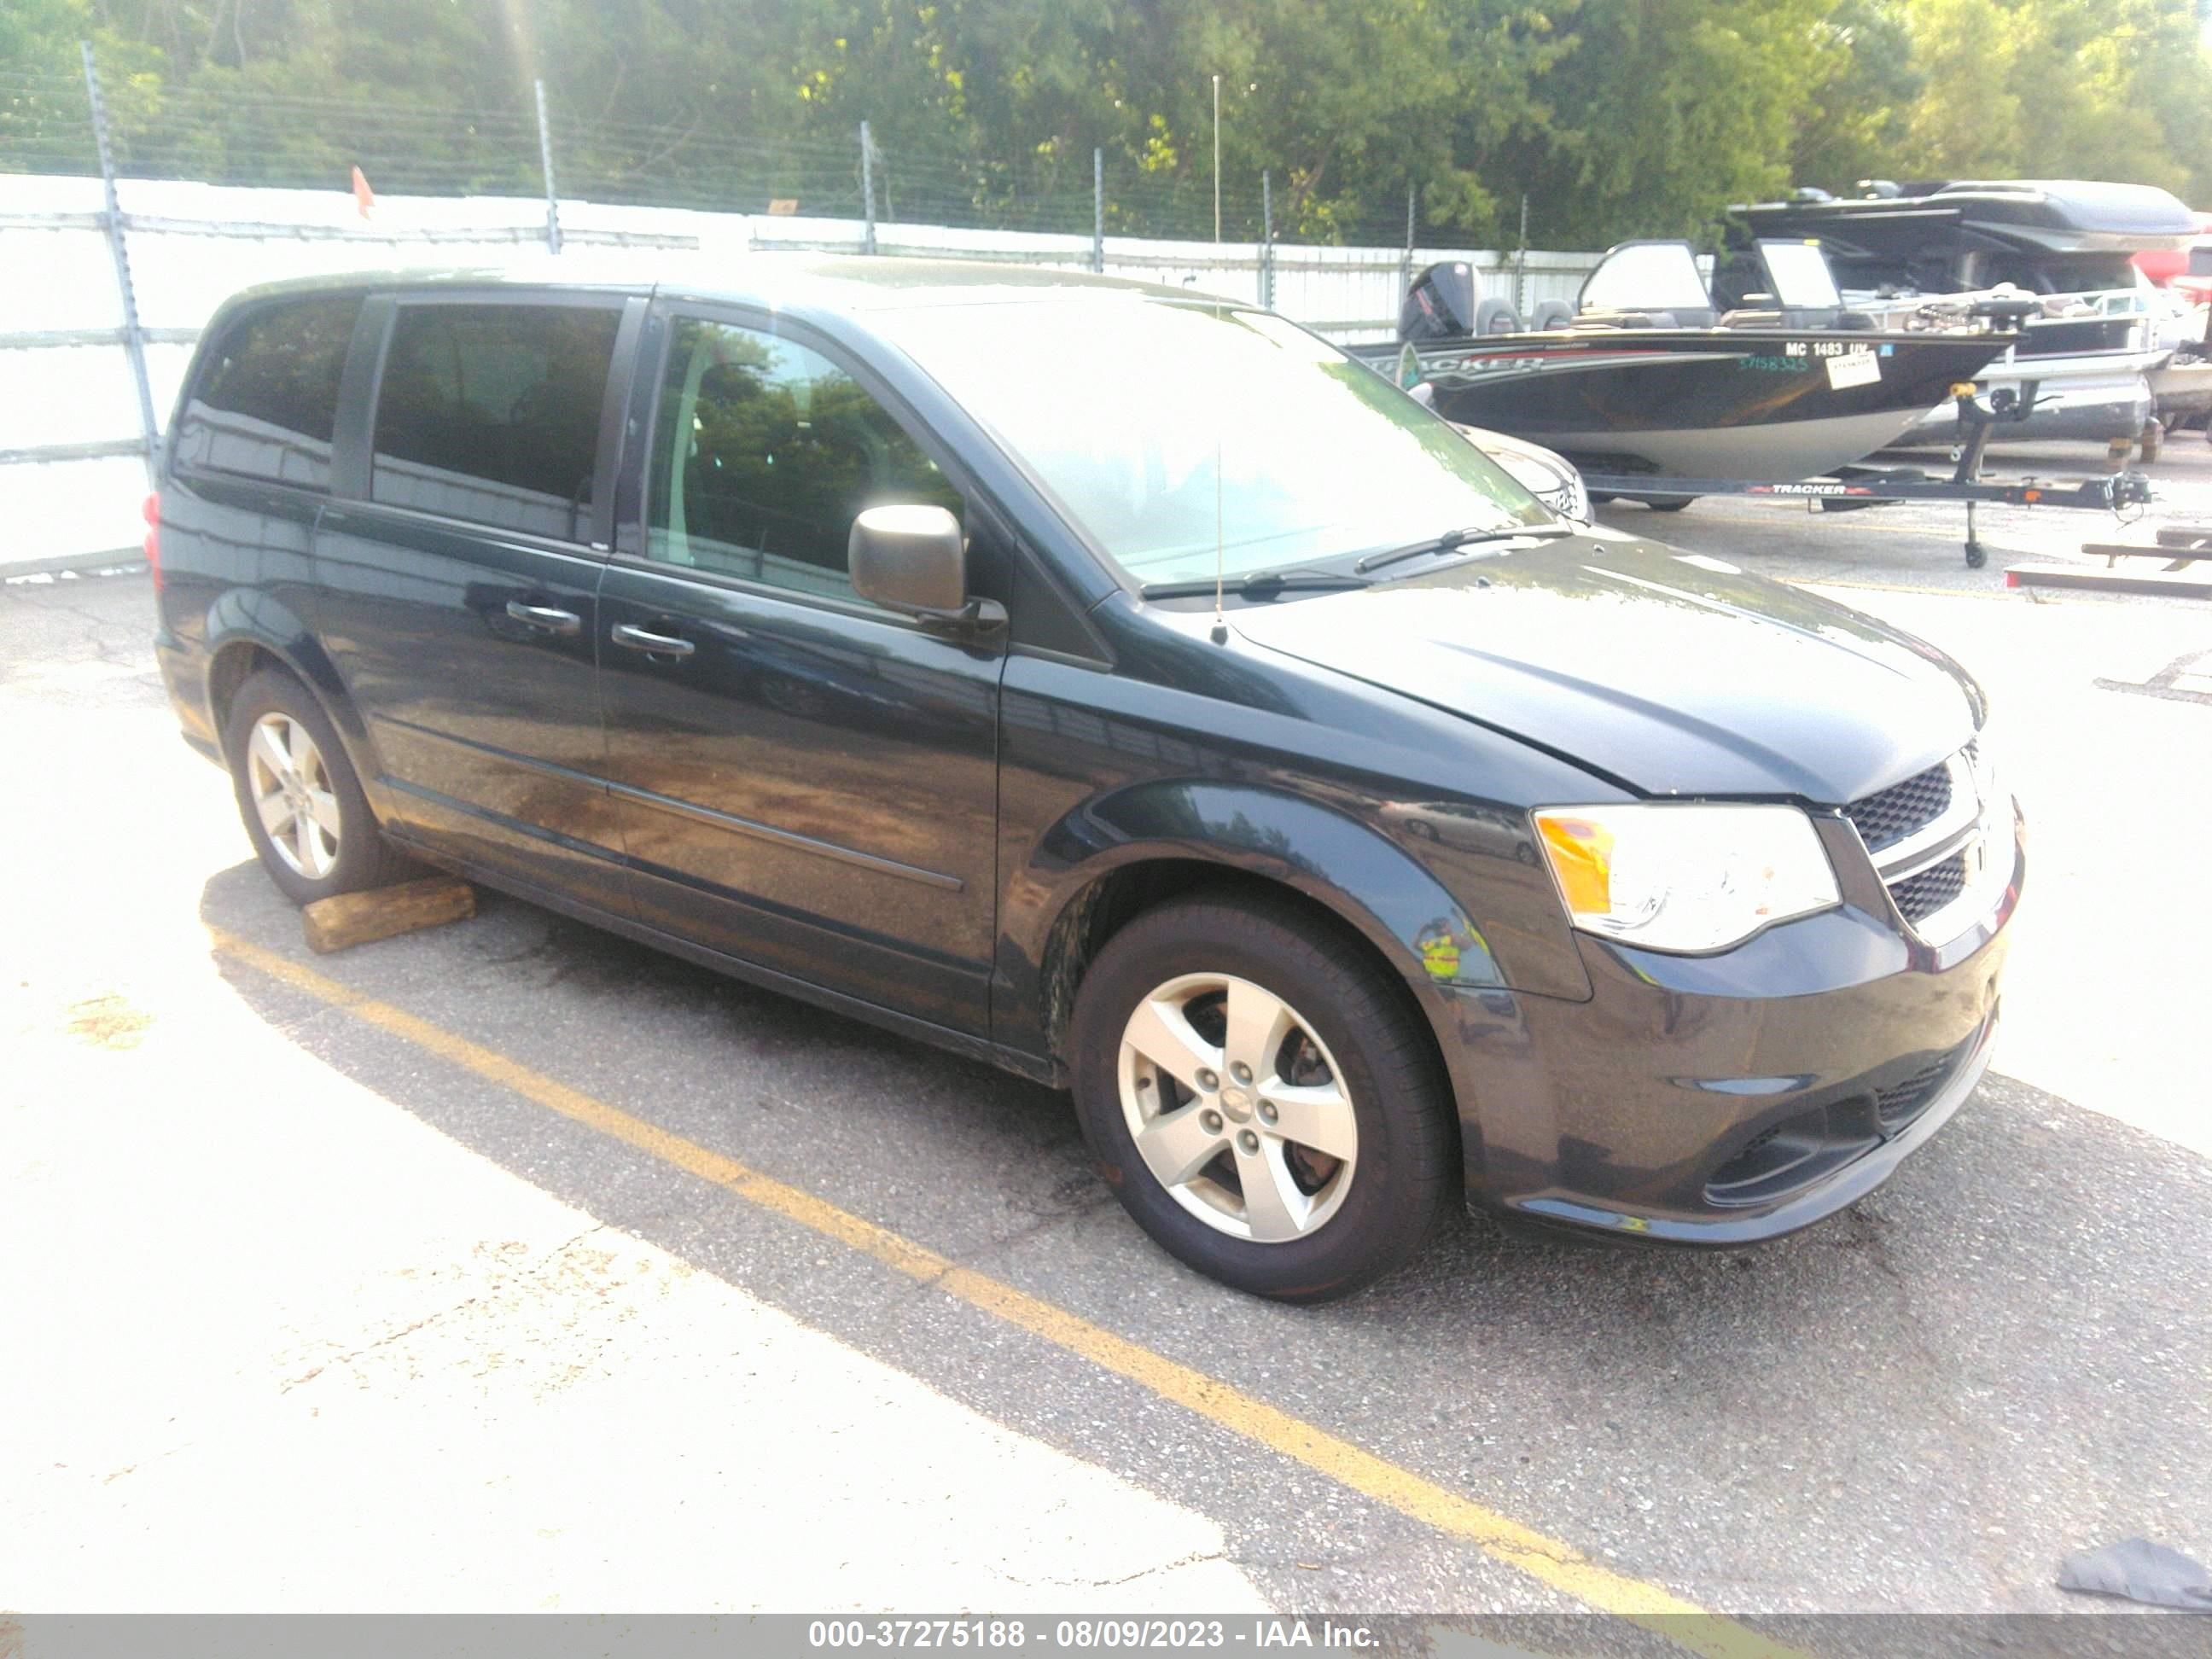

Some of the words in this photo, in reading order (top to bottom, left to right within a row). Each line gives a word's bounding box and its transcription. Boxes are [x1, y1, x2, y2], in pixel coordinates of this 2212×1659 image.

[1786, 342, 1807, 356] MC
[1813, 342, 1843, 356] 1483
[1368, 357, 1545, 373] RCKER
[1773, 485, 1846, 494] TRACKER
